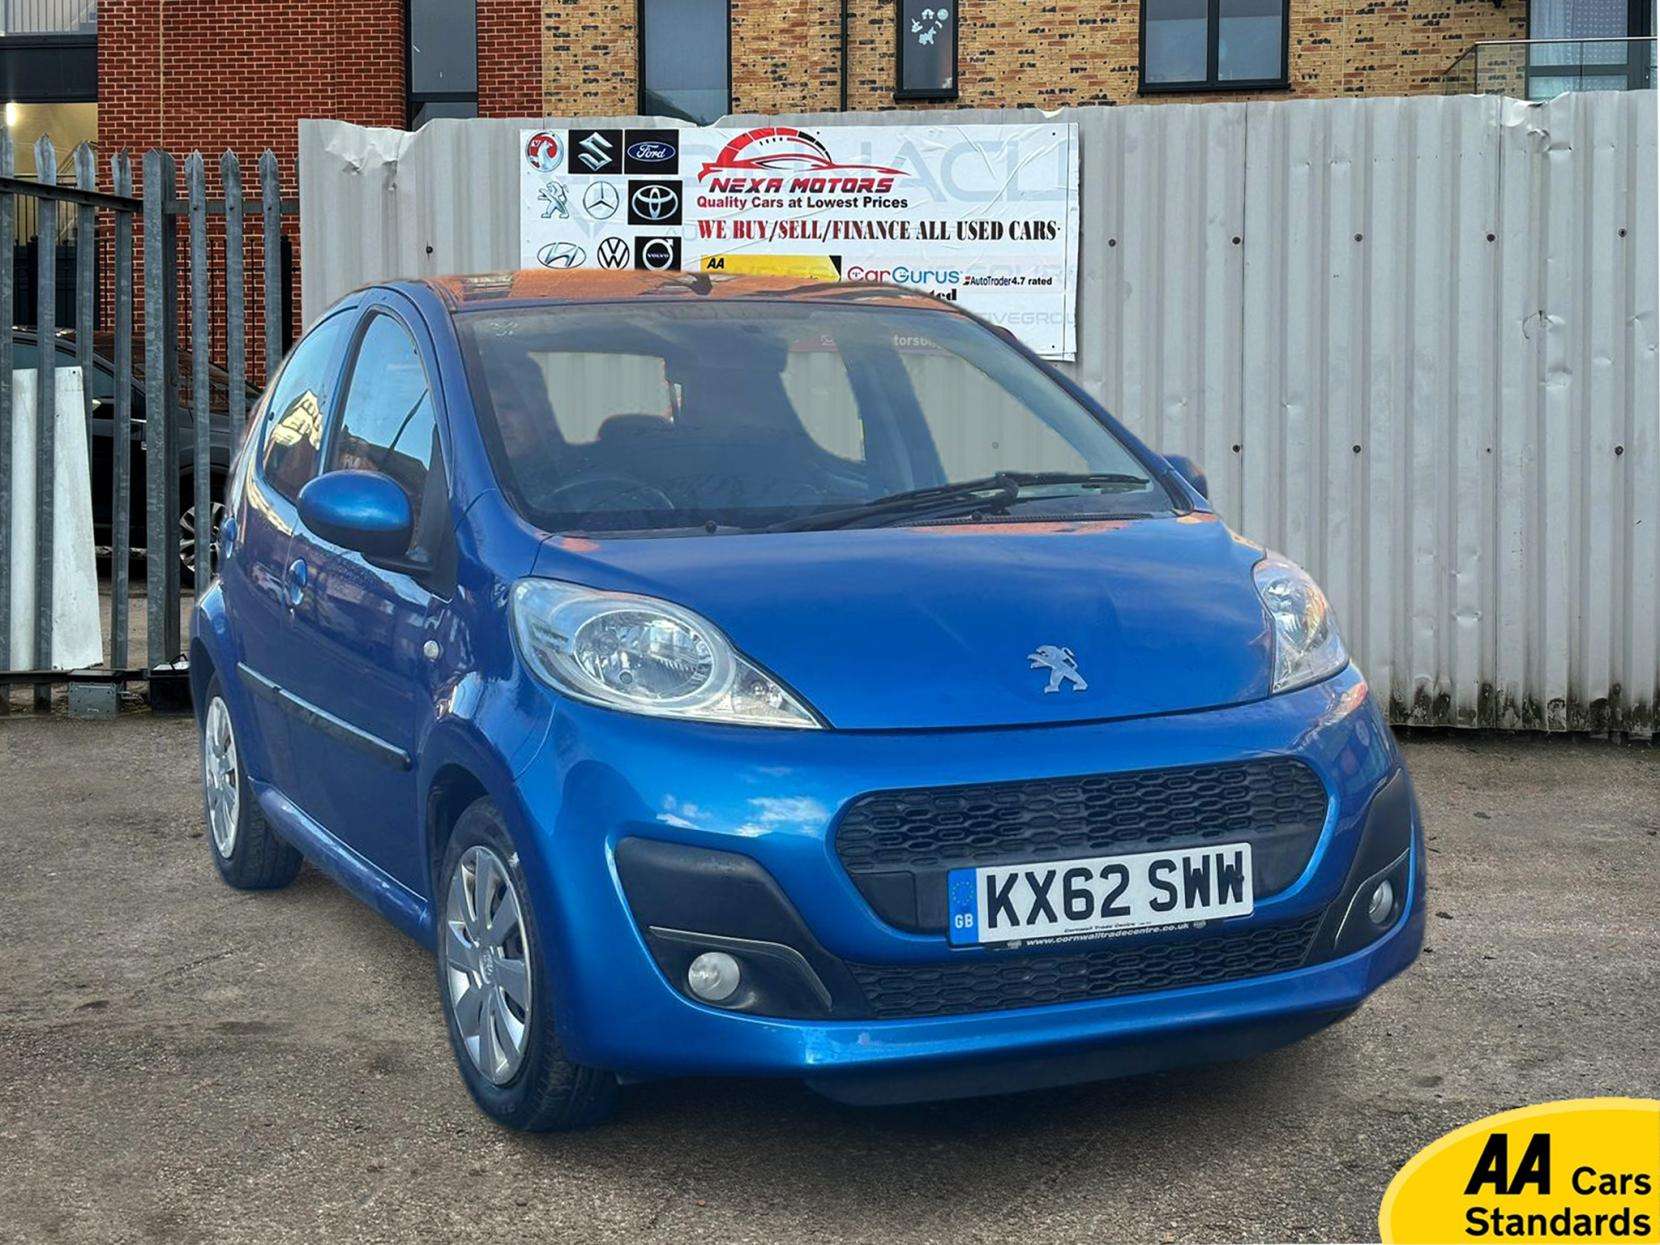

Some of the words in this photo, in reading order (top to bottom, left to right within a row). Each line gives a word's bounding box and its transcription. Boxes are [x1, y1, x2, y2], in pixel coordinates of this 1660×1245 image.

[636, 145, 666, 158] Ford
[709, 178, 783, 193] NEXA
[789, 178, 894, 193] MOTORS
[697, 196, 746, 210] Quality
[752, 196, 784, 208] Cars
[788, 197, 803, 208] at
[807, 196, 859, 208] Lowest
[863, 196, 908, 208] Prices
[697, 220, 726, 240] WE
[916, 220, 950, 240] ALL
[957, 220, 1003, 240] USED
[1009, 220, 1057, 240] CARS
[707, 258, 725, 269] AA
[847, 266, 960, 284] CarGurus
[1028, 276, 1052, 286] rated
[986, 863, 1131, 930] KX62
[1148, 850, 1245, 912] SWW
[954, 914, 974, 929] GB
[1026, 922, 1189, 946] www.cornwalltradecentre.co.uk
